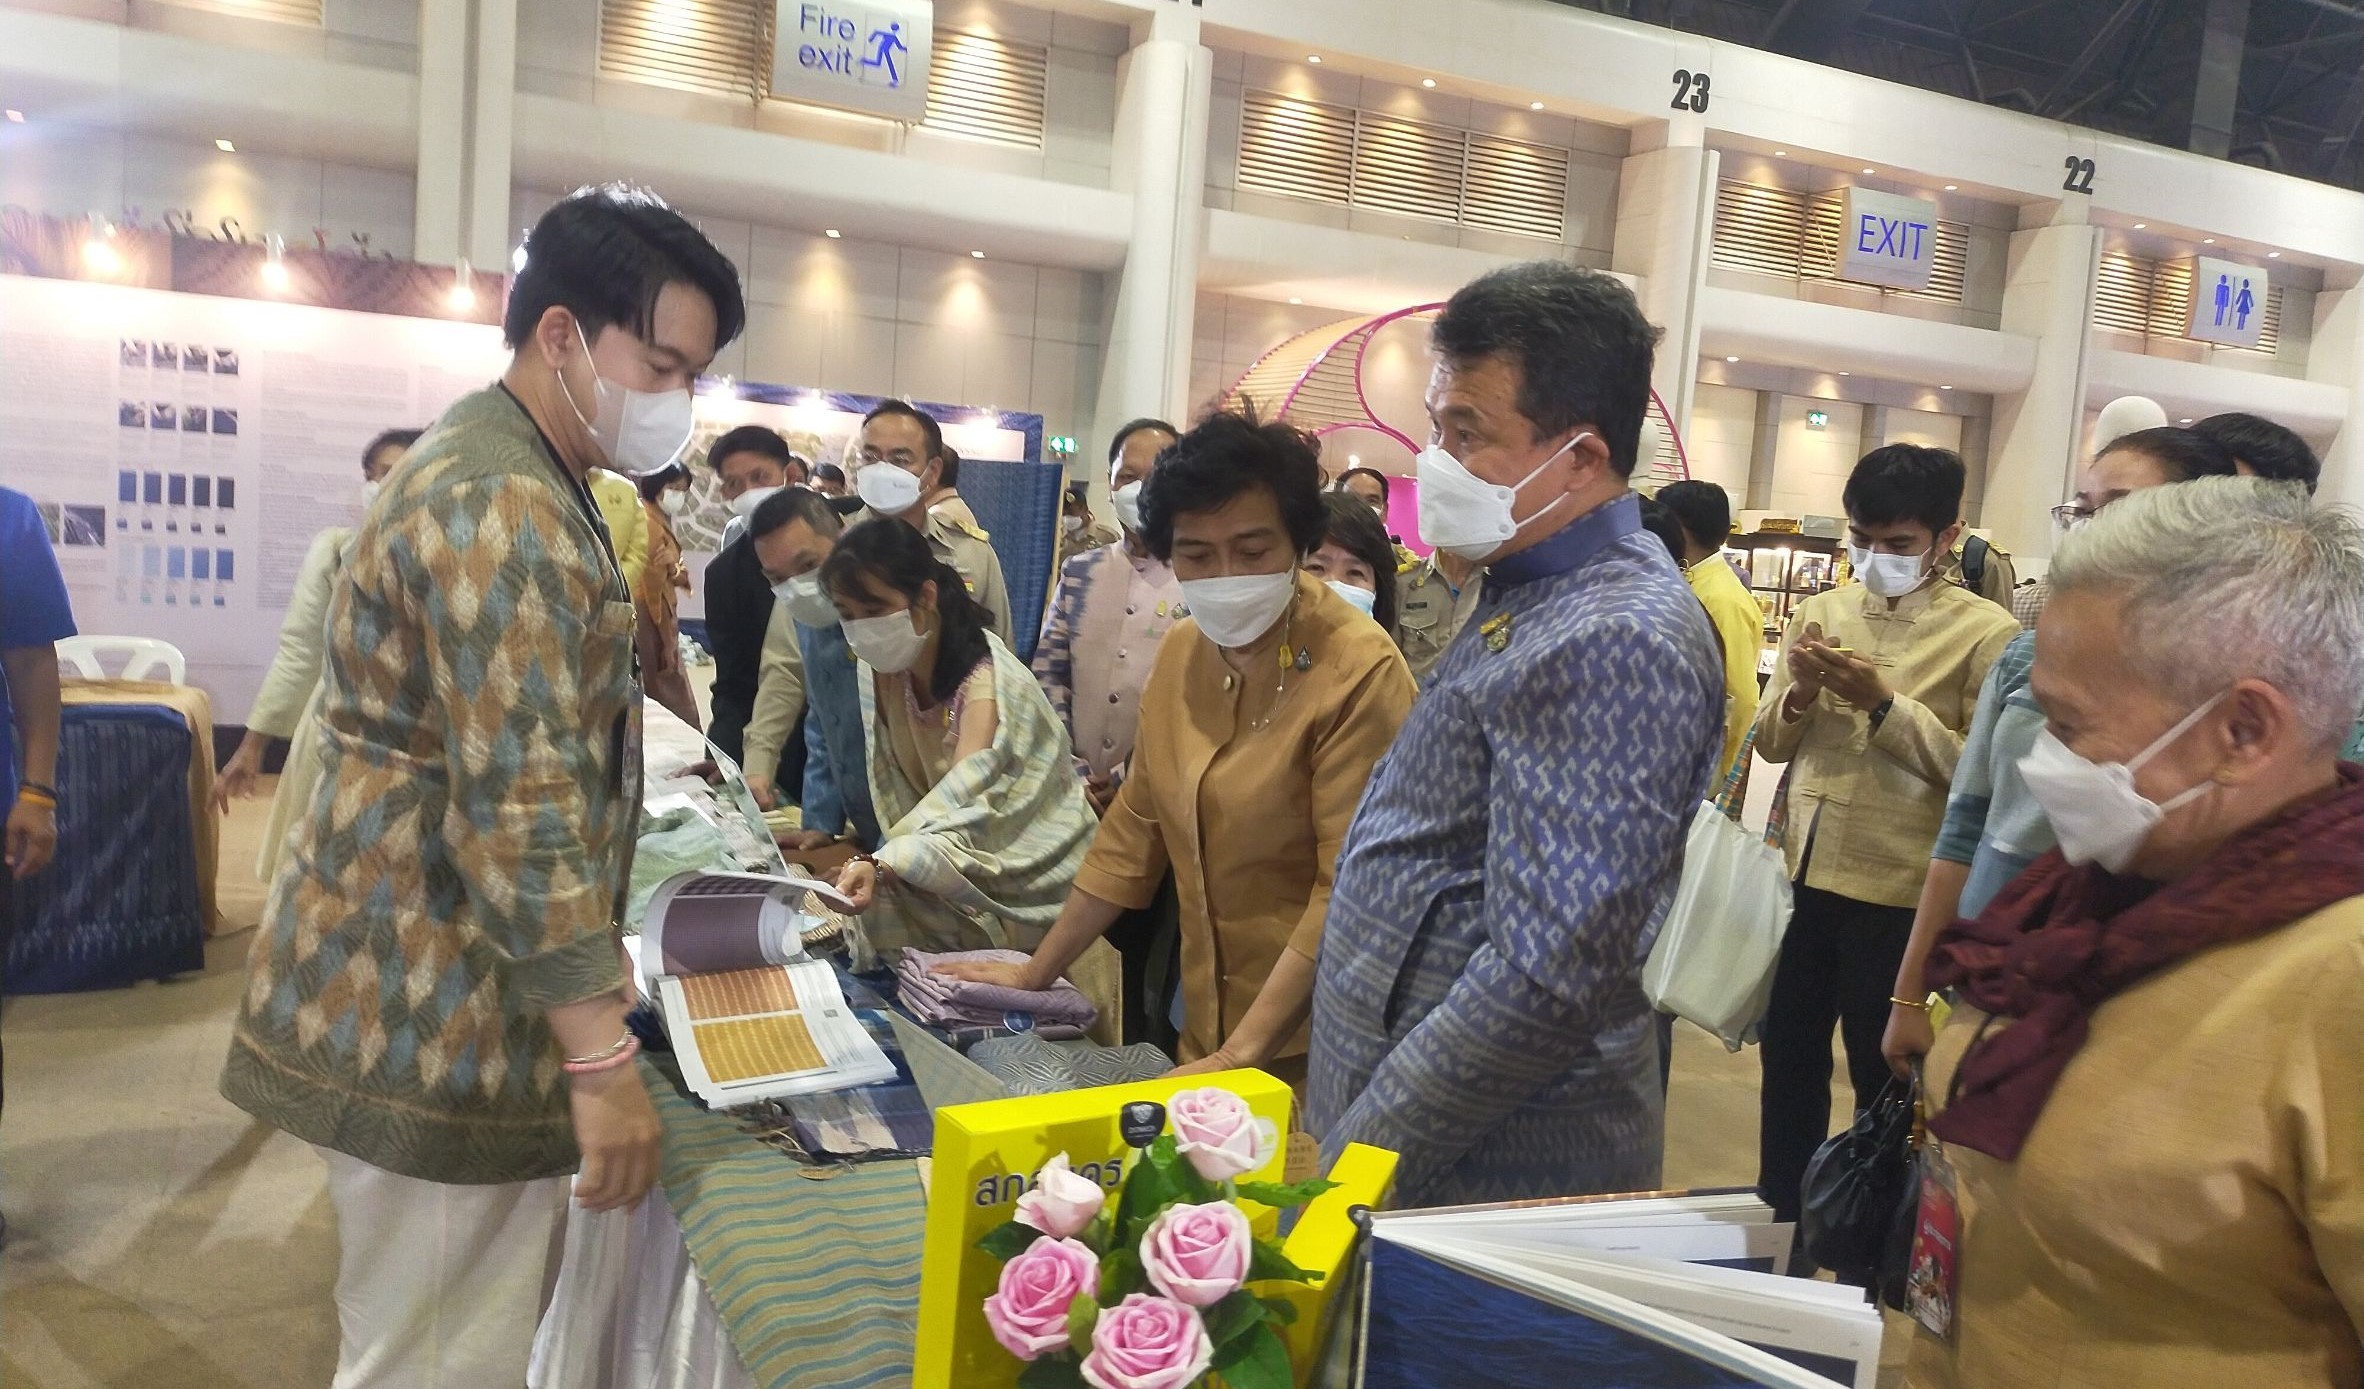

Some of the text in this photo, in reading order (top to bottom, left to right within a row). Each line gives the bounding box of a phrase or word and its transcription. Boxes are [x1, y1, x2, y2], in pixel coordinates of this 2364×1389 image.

[800, 3, 856, 41] Fire
[798, 44, 853, 76] exit
[1671, 69, 1711, 114] 23
[2063, 155, 2095, 195] 22
[1858, 214, 1929, 260] EXIT
[975, 1158, 1123, 1207] สกคร
